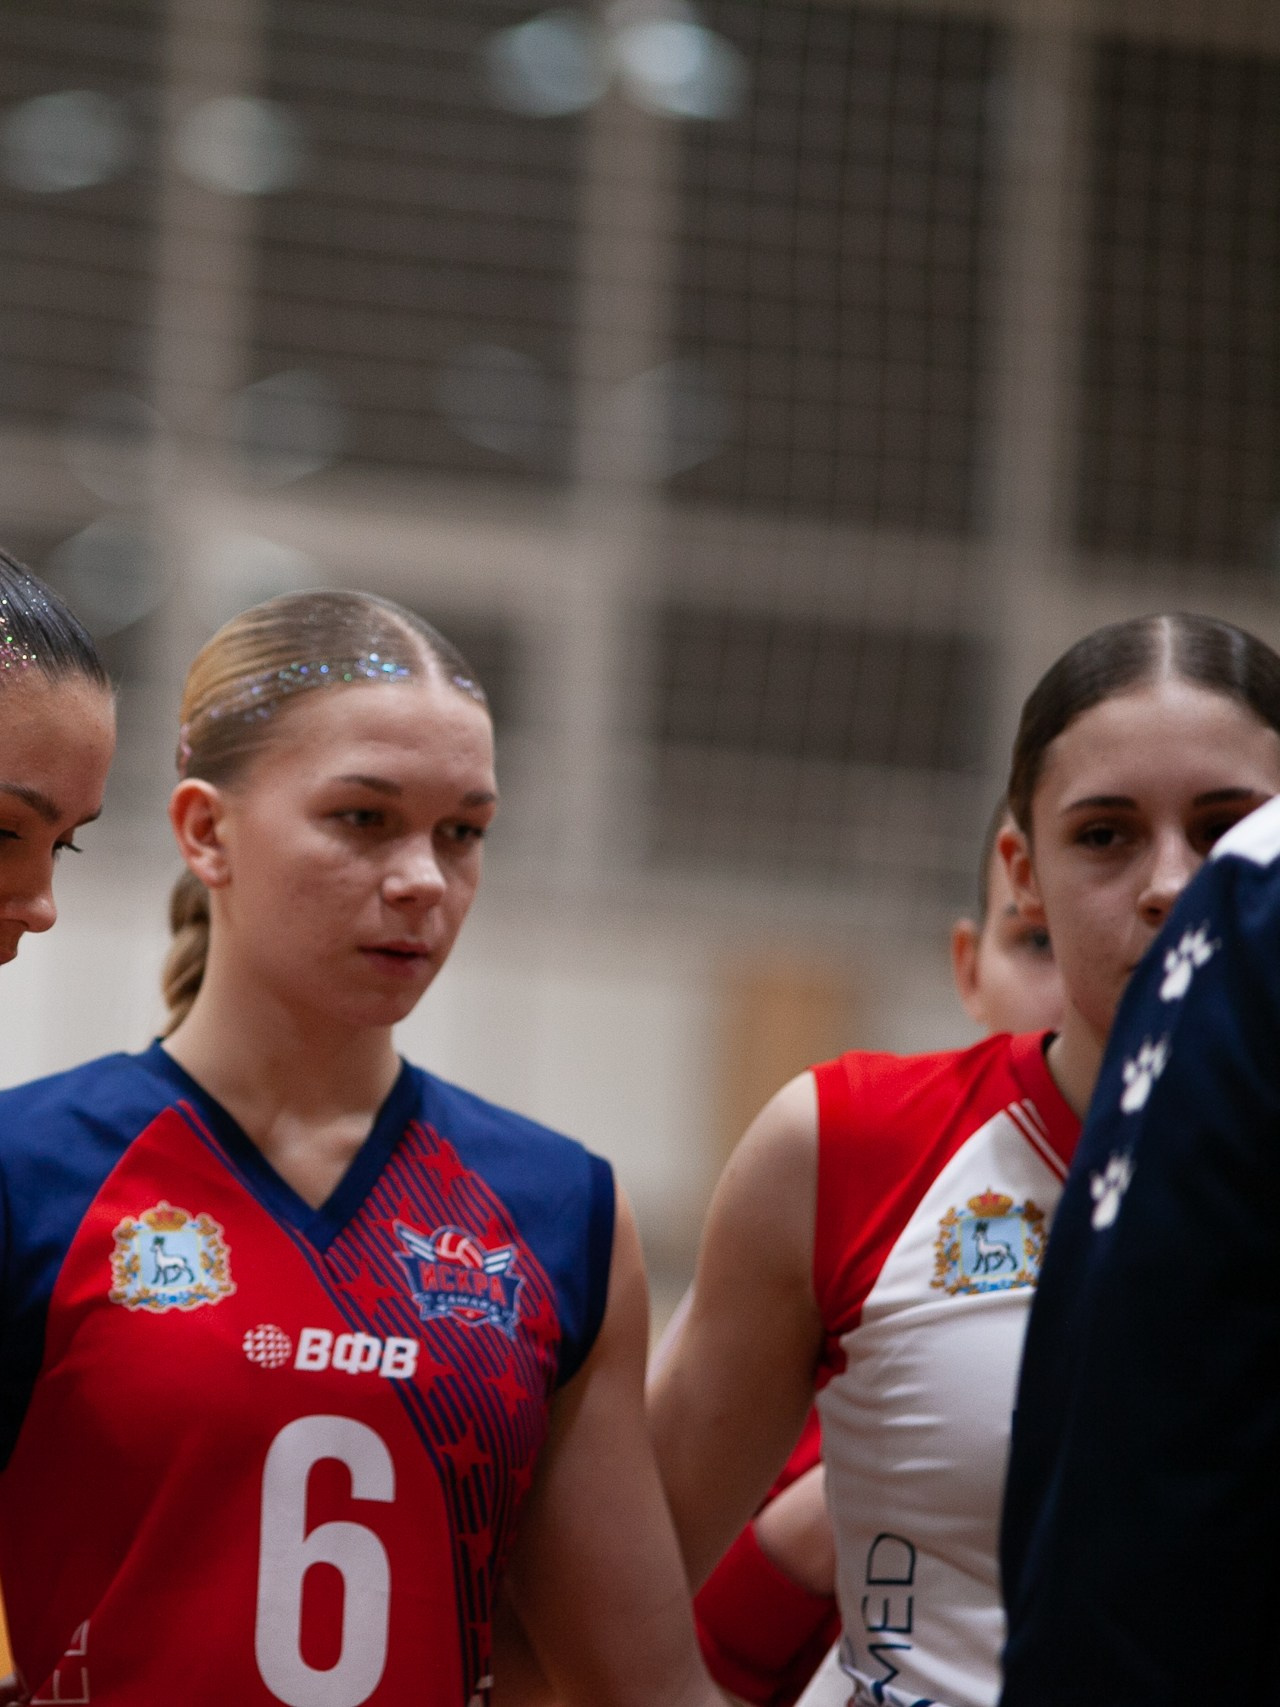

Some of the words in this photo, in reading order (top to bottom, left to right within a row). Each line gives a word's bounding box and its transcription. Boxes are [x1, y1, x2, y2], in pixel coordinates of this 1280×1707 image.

[418, 1260, 508, 1307] ИСКРА
[294, 1327, 419, 1379] ВФВ
[254, 1414, 397, 1707] 6
